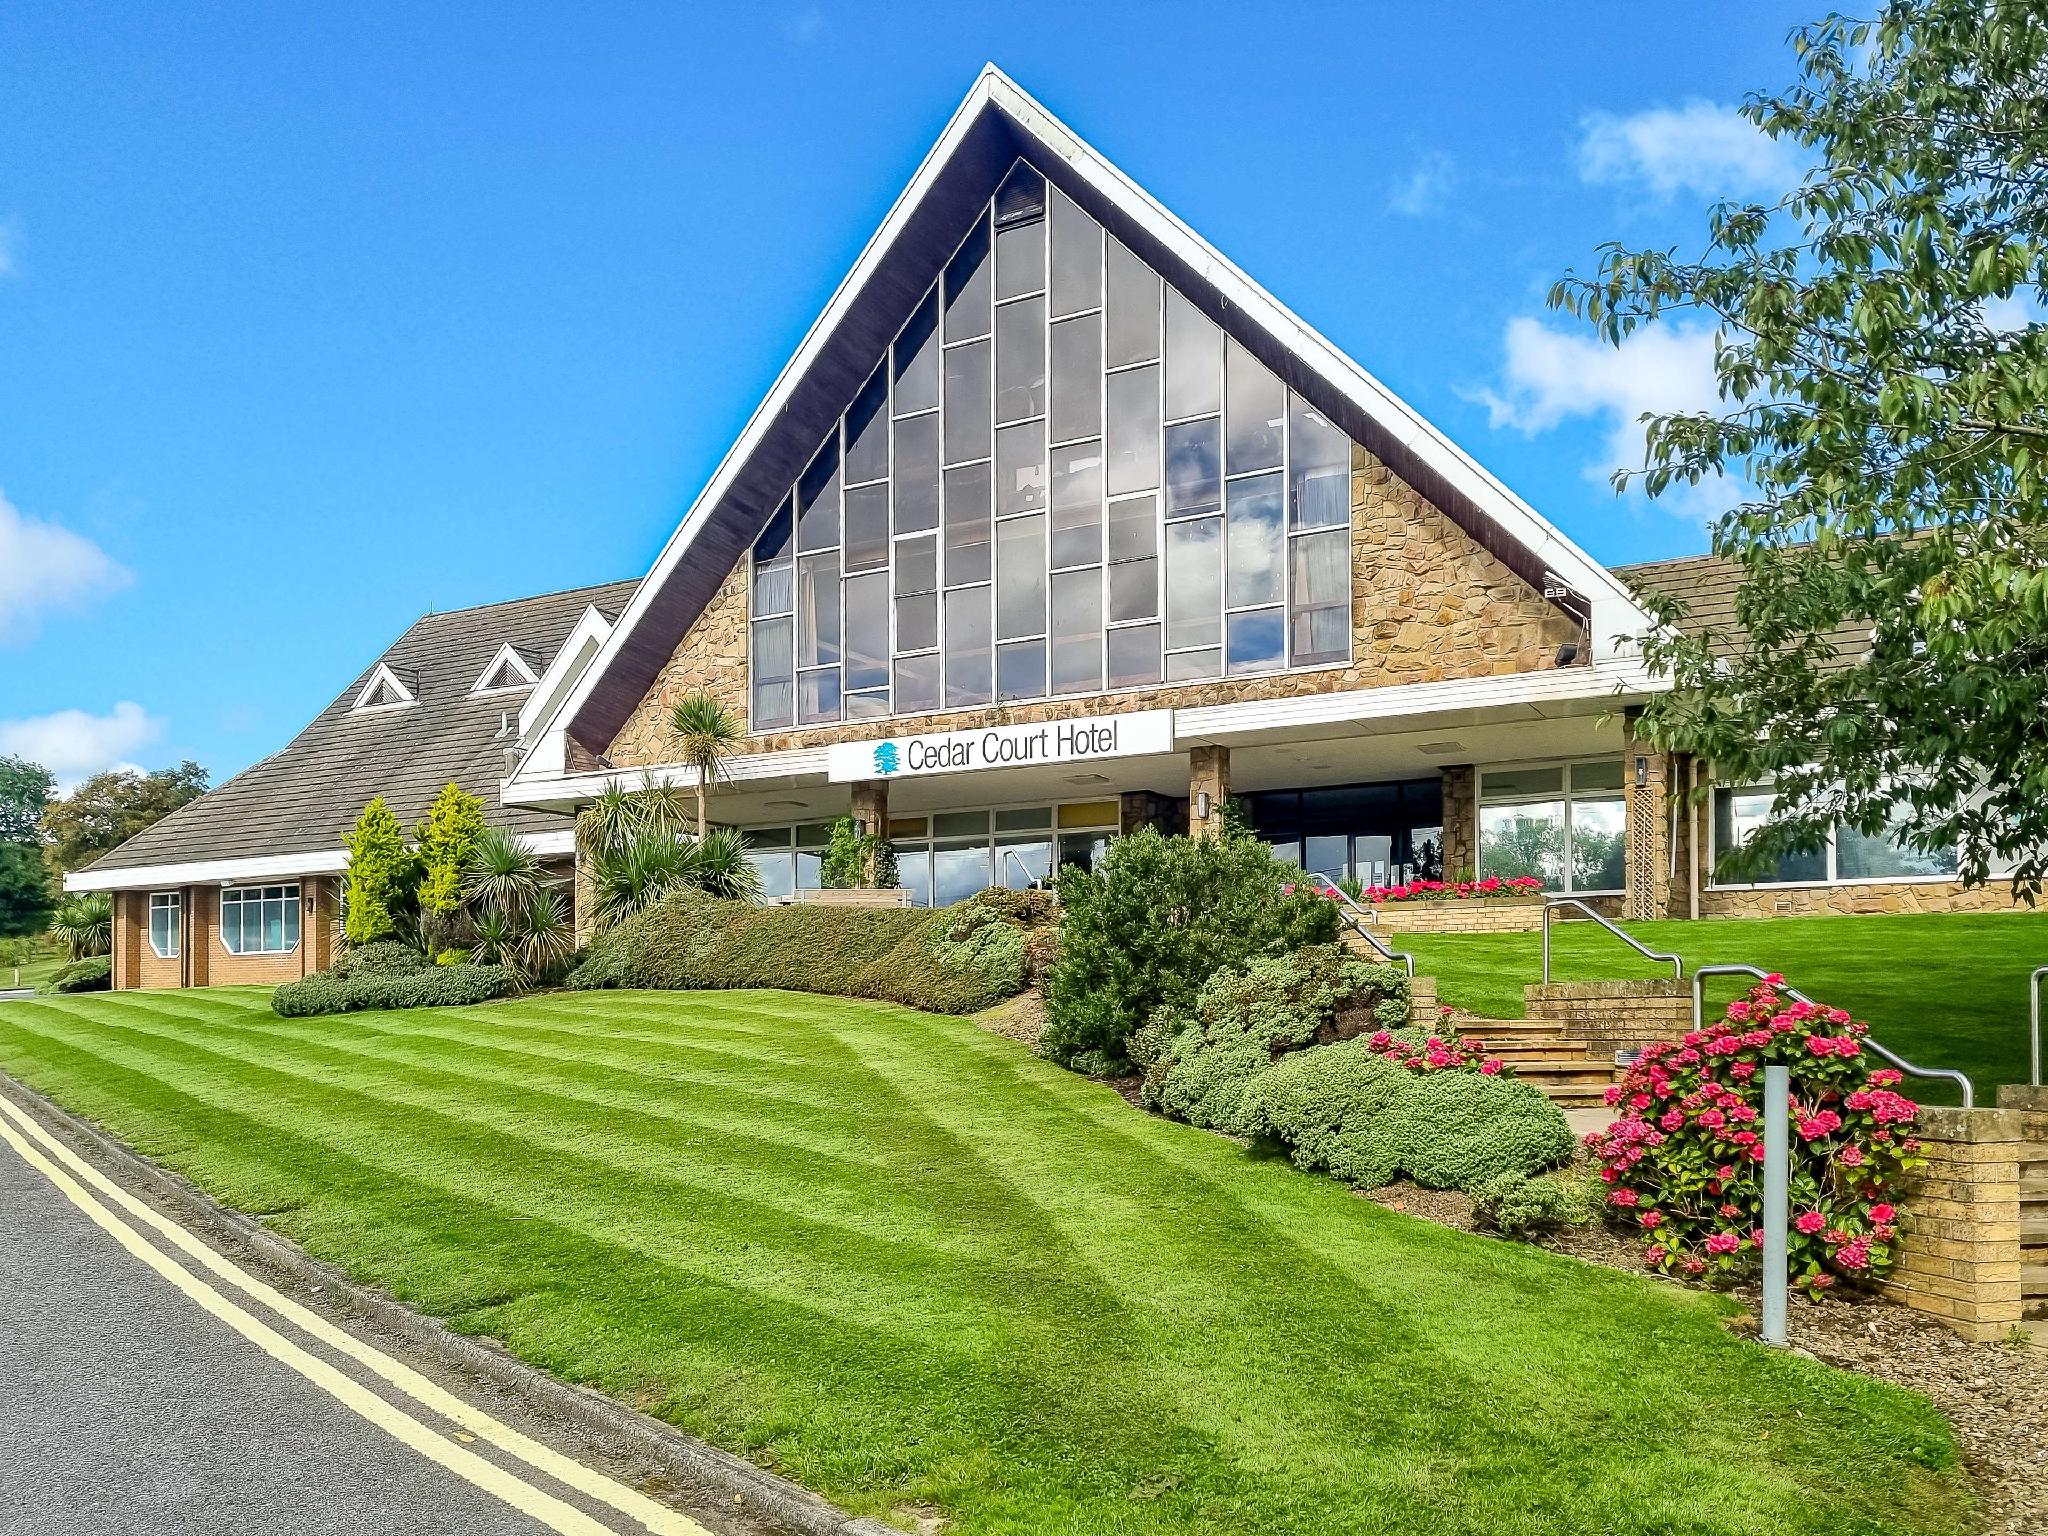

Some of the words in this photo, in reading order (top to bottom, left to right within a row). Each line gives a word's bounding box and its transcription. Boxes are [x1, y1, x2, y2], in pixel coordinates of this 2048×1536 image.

[908, 737, 974, 770] Cedar
[982, 728, 1049, 764] Court
[1057, 720, 1118, 757] Hotel
